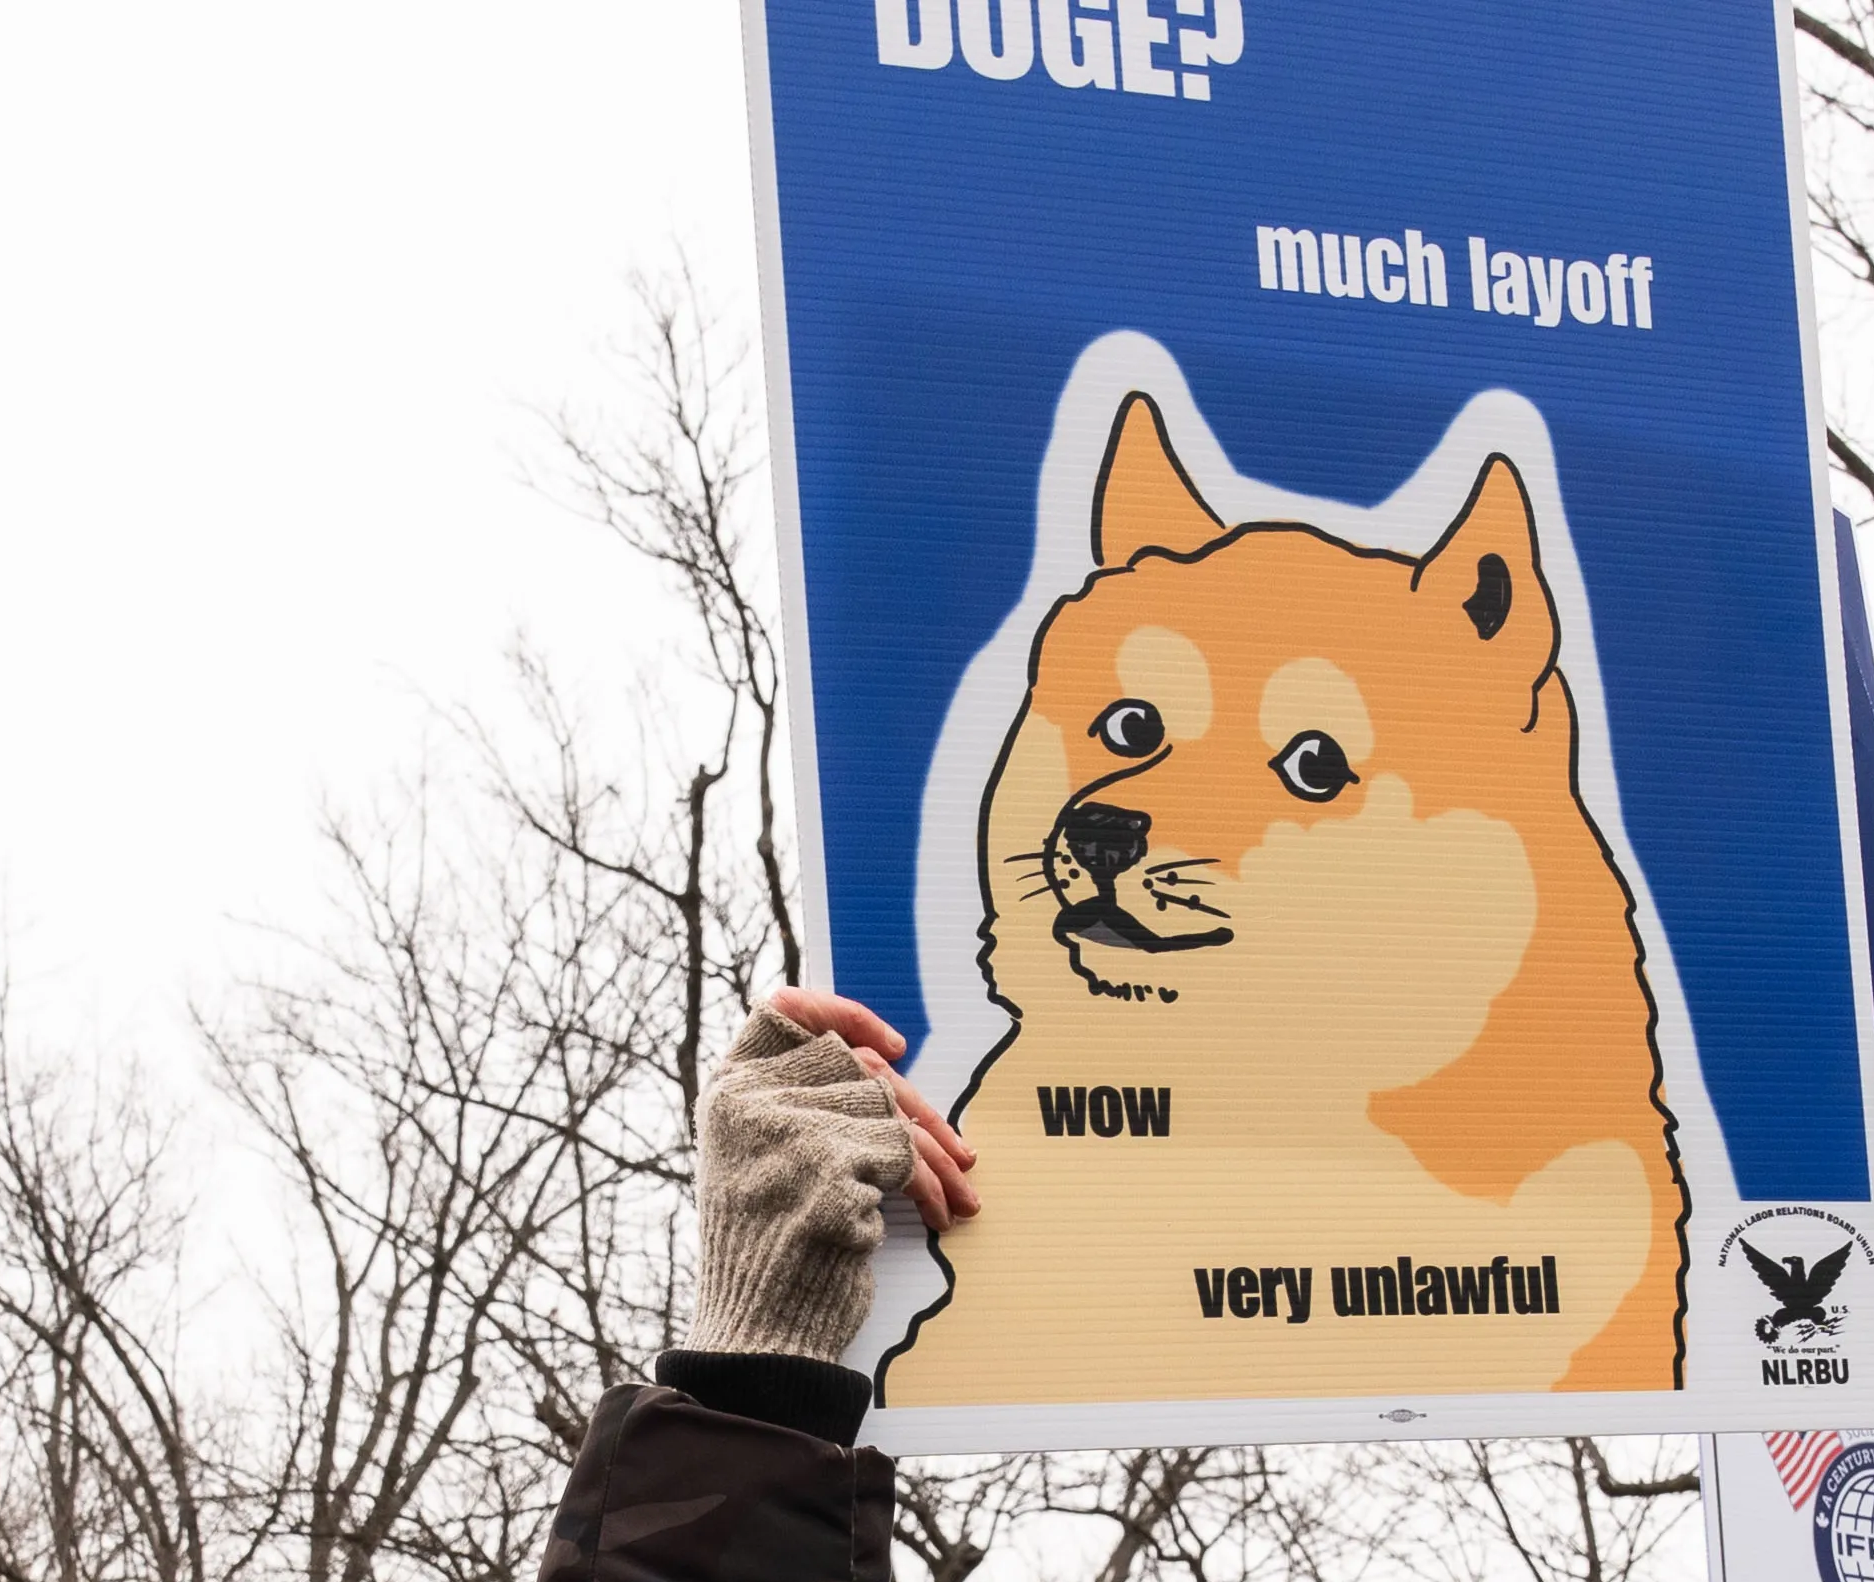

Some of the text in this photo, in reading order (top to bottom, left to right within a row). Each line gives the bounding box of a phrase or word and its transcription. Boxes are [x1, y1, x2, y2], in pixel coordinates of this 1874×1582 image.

[1255, 225, 1653, 330] much layoff
[1036, 1085, 1171, 1138] wow
[1718, 1224, 1745, 1267] NATIONAL
[1744, 1209, 1774, 1226] LABOR
[1776, 1206, 1825, 1219] RELATIONS
[1827, 1213, 1856, 1235] BOARD
[1193, 1255, 1560, 1324] very unlawful
[1831, 1305, 1851, 1314] U.S.
[1788, 1345, 1799, 1354] do
[1762, 1358, 1849, 1385] NLRBU
[1822, 1494, 1833, 1509] A
